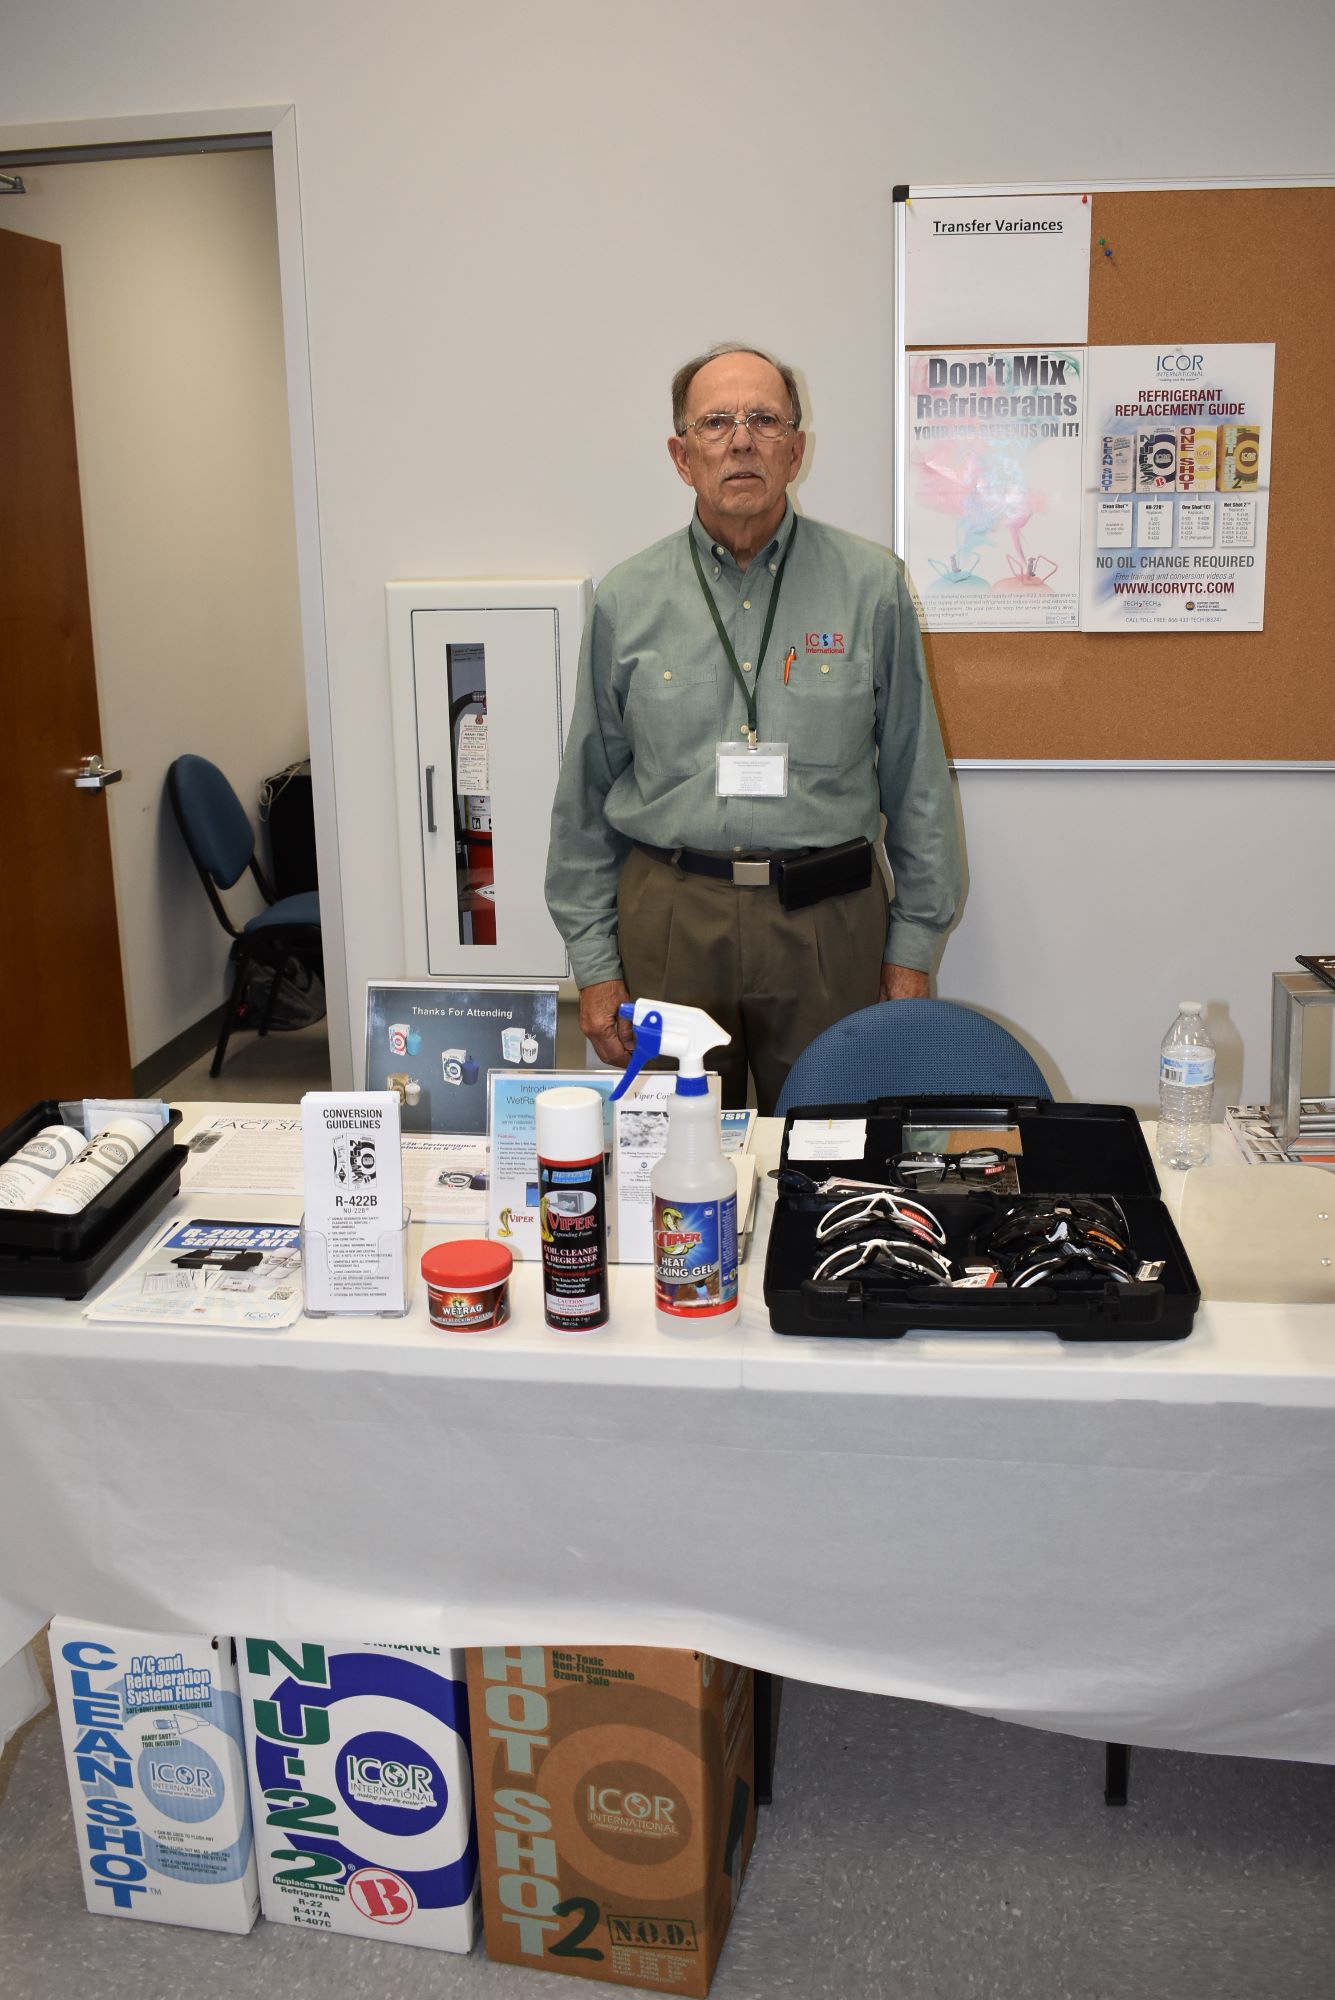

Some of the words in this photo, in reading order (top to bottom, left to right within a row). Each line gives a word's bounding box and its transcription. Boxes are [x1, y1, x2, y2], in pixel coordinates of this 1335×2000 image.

[933, 219, 991, 234] Transfer
[995, 218, 1063, 232] Variances
[1013, 355, 1066, 386] Mix
[1157, 355, 1204, 371] ICOR
[1139, 390, 1223, 402] REFRIGERANT
[917, 393, 1077, 419] Refrigerants
[1115, 403, 1204, 417] REPLACEMENT
[1208, 402, 1245, 416] GUIDE
[914, 426, 948, 440] YOUR
[1041, 423, 1058, 437] ON
[1062, 423, 1079, 437] IT!
[1180, 427, 1195, 451] ONE
[1103, 437, 1113, 465] CLEAN
[1102, 468, 1112, 491] SHOT
[1179, 458, 1194, 490] SHOT
[1096, 556, 1113, 568] NO
[1117, 556, 1136, 568] OIL
[1140, 556, 1190, 568] CHANGE
[1194, 555, 1255, 568] REQUIRED
[1115, 573, 1129, 581] Free
[1131, 573, 1155, 582] training
[1206, 572, 1227, 580] videos
[1113, 582, 1235, 594] WWW.ICORVTC.COM
[412, 1007, 445, 1016] Thanks
[449, 1007, 465, 1016] For
[466, 1008, 513, 1019] Attending
[507, 1096, 536, 1104] WetRa
[634, 1092, 654, 1101] Viper
[323, 1109, 383, 1118] CONVERSION
[211, 1121, 269, 1130] FACT
[275, 1122, 302, 1131] SH
[326, 1120, 381, 1129] GUIDELINES
[335, 1195, 378, 1207] R-422B
[509, 1214, 534, 1223] VIPER
[547, 1208, 595, 1231] VIPER
[181, 1228, 255, 1239] R-290
[255, 1229, 300, 1239] SYS
[655, 1231, 702, 1248] VIPER
[181, 1238, 260, 1246] SERVICE
[258, 1238, 294, 1247] KIT
[543, 1245, 559, 1255] COIL
[560, 1246, 598, 1256] CLEANER
[550, 1254, 597, 1264] DEGREASER
[661, 1257, 684, 1267] HEAT
[692, 1265, 713, 1276] GEL
[442, 1304, 483, 1315] WETRAG
[133, 1656, 155, 1674] A/C
[158, 1654, 182, 1672] and
[552, 1650, 604, 1666] Non-Toxic
[552, 1660, 635, 1680] Non-Flammable
[553, 1669, 584, 1683] Ozone
[587, 1675, 609, 1686] Safe
[126, 1669, 210, 1690] Refrigeration
[127, 1688, 174, 1706] System
[175, 1685, 209, 1701] Flush
[62, 1641, 134, 1788] CLEAN
[482, 1646, 549, 1775] HOT
[152, 1763, 210, 1787] ICOR
[350, 1757, 430, 1792] ICOR
[153, 1782, 214, 1795] INTERNATIONAL
[350, 1783, 434, 1803] INTERNATIONAL
[589, 1785, 674, 1823] ICOR
[590, 1813, 678, 1834] INTERNATIONAL
[86, 1799, 148, 1908] SHOT
[493, 1789, 561, 1956] SHOT
[274, 1876, 316, 1889] Replaces
[318, 1883, 344, 1894] These
[281, 1886, 340, 1902] Refrigerants
[356, 1879, 409, 1917] B
[298, 1898, 323, 1908] R-22
[293, 1906, 331, 1918] R-417A
[294, 1915, 332, 1928] R-407C
[548, 1897, 604, 1960] 2
